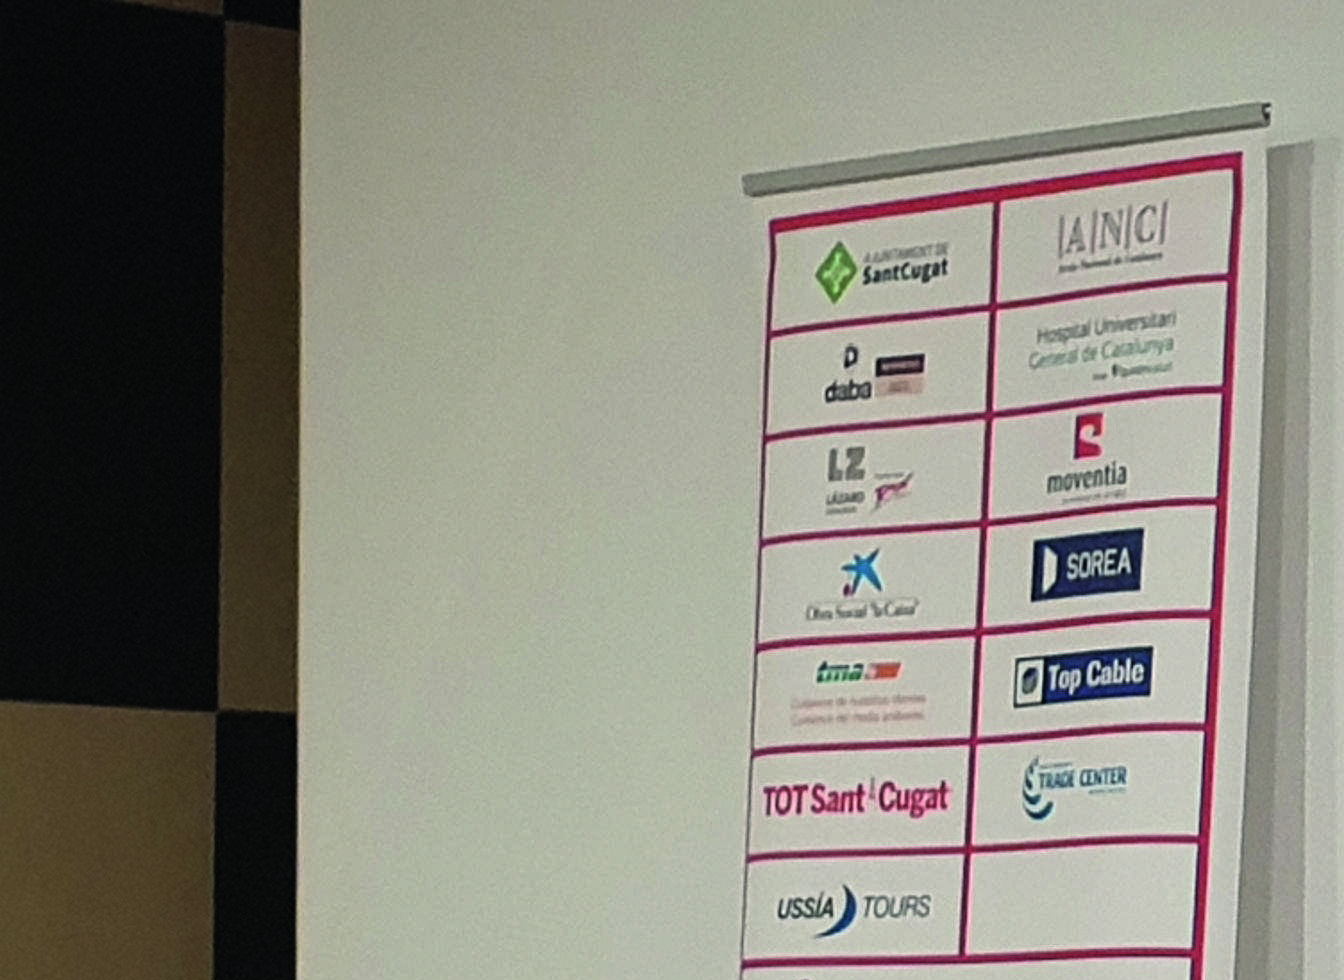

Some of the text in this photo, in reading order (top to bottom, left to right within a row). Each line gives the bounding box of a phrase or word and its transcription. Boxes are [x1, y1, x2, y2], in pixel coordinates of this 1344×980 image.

[1037, 317, 1091, 344] Hospital
[1047, 460, 1127, 494] moventia
[1066, 547, 1132, 580] SOREA
[1048, 657, 1145, 695] Top Cable
[1079, 765, 1127, 787] CENTER
[764, 780, 948, 819] TOT Sant Cugat
[777, 891, 932, 919] USSÍA TOURS
